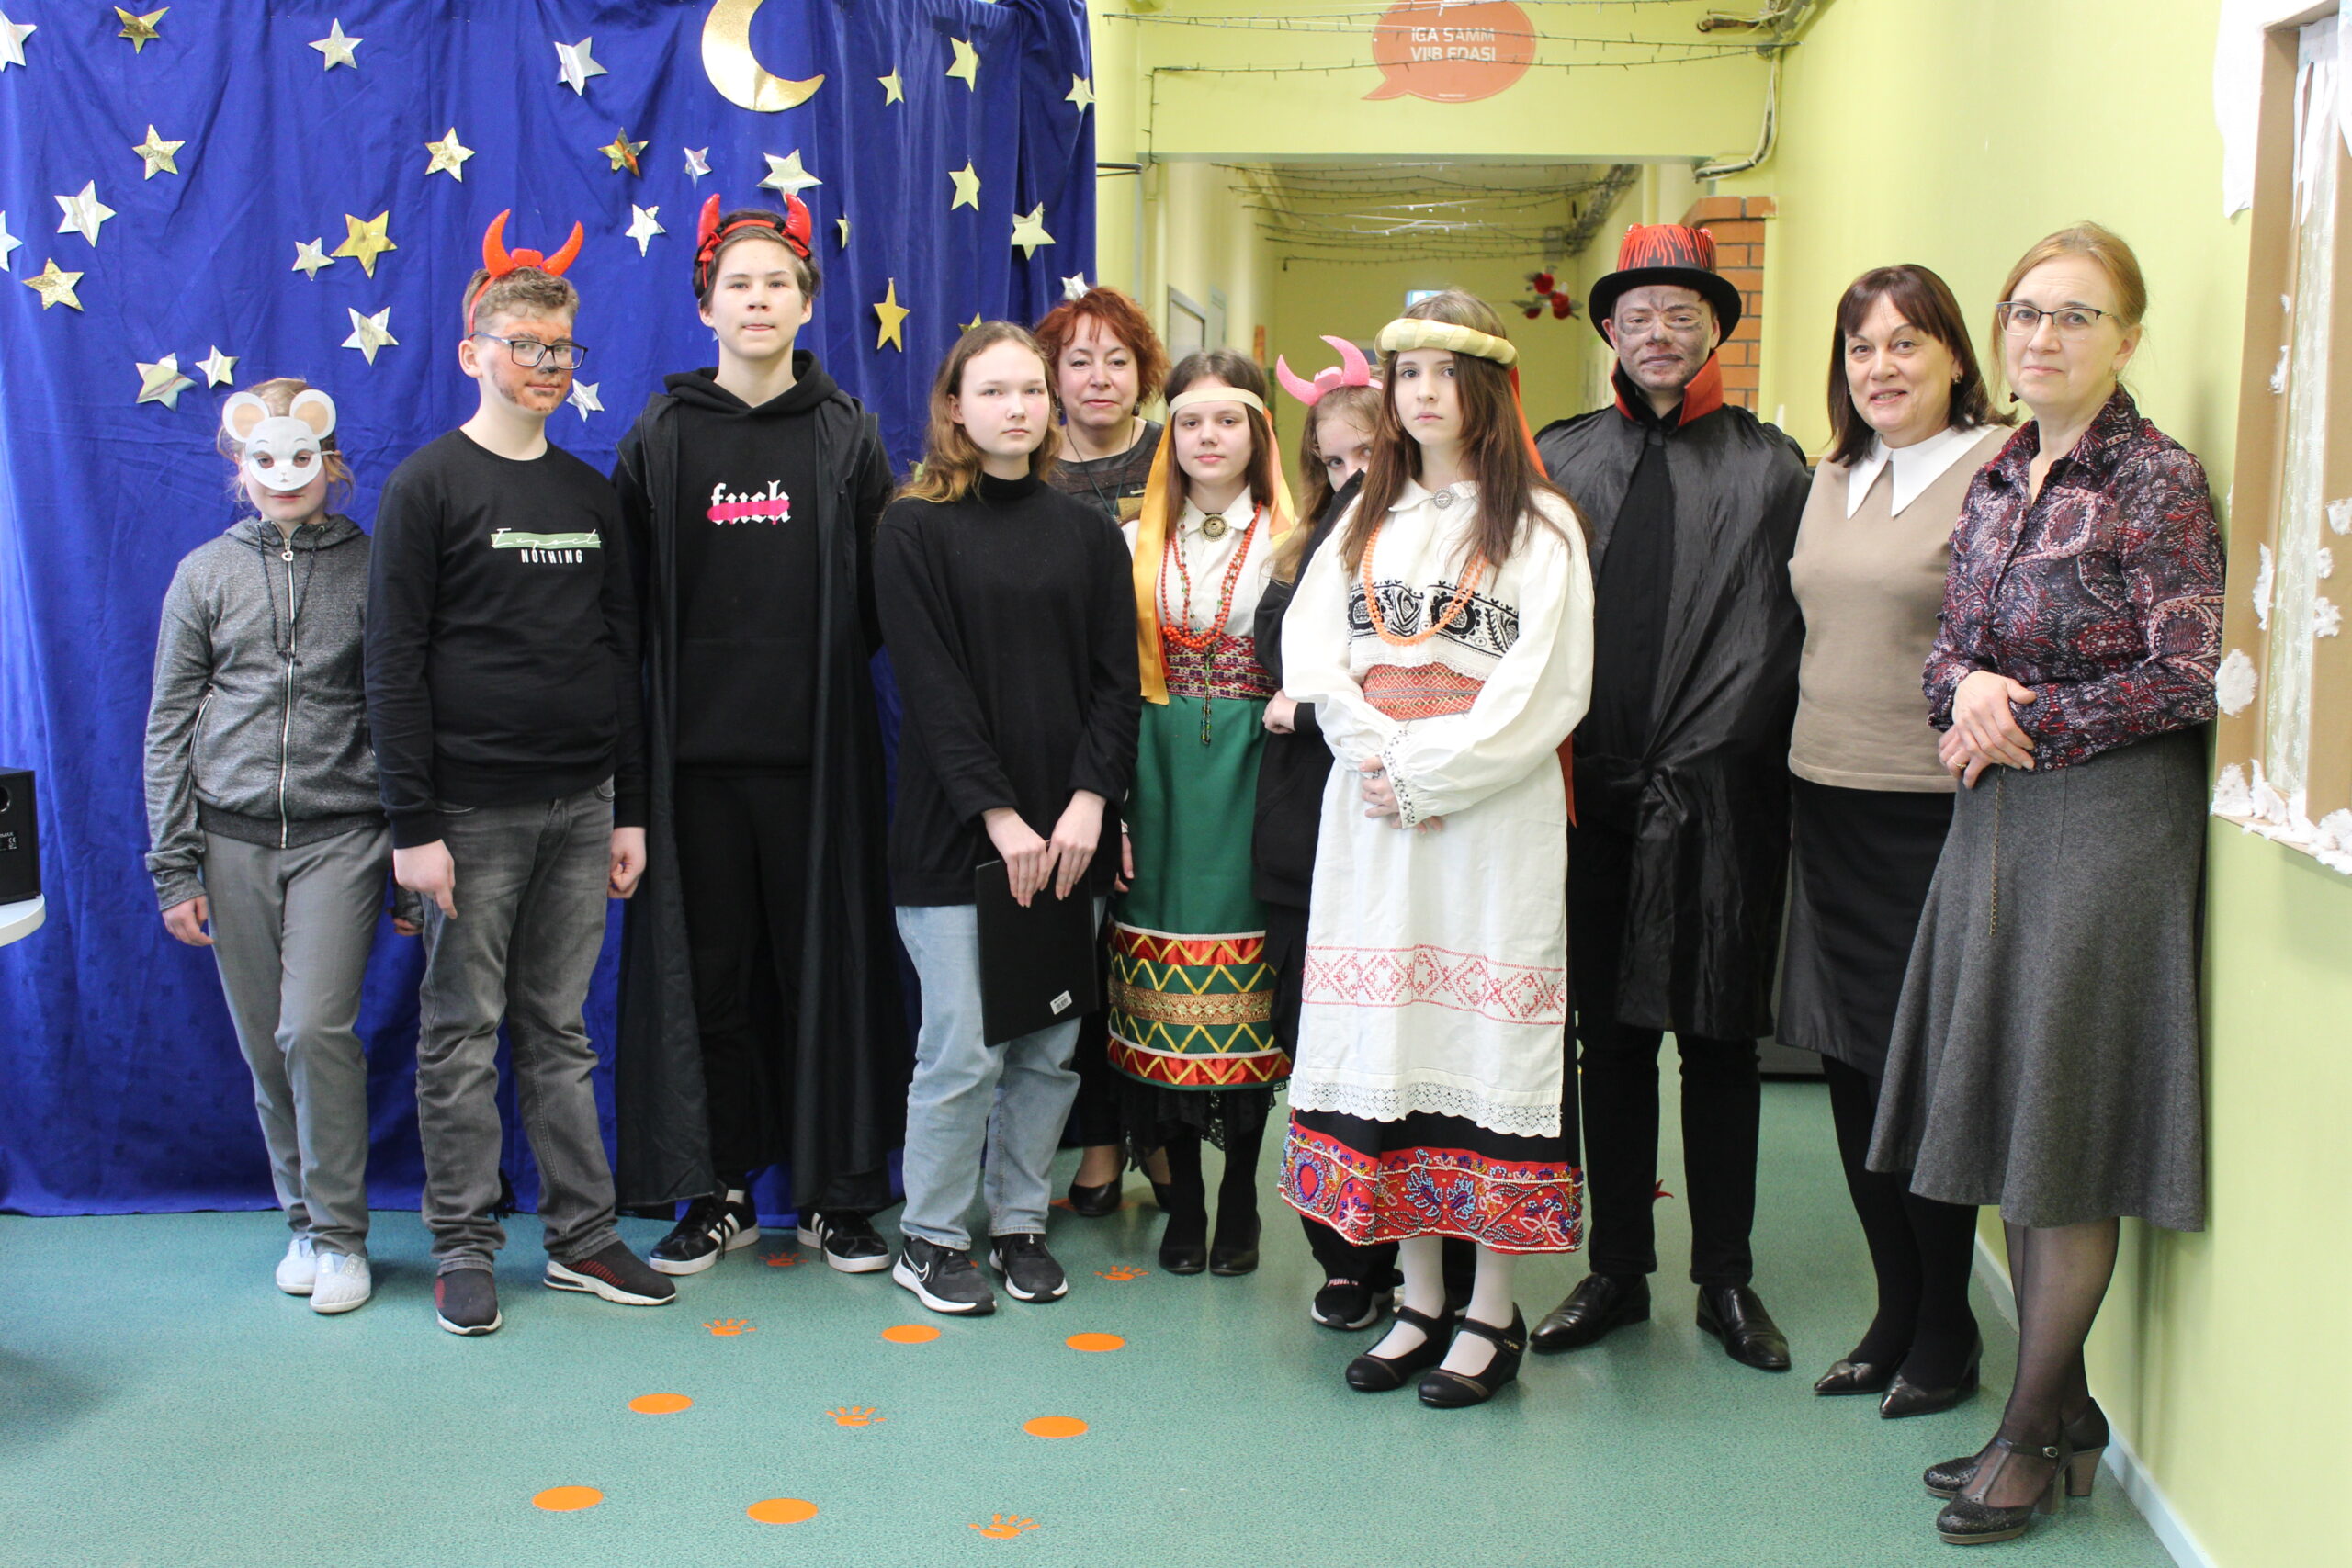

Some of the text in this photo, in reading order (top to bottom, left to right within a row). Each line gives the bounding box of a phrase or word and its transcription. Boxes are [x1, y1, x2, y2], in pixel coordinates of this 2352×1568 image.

[1411, 28, 1495, 42] IGA SAMM
[1410, 47, 1496, 62] VIIB EDASI
[491, 527, 602, 550] Expect
[520, 549, 582, 564] NOTHING
